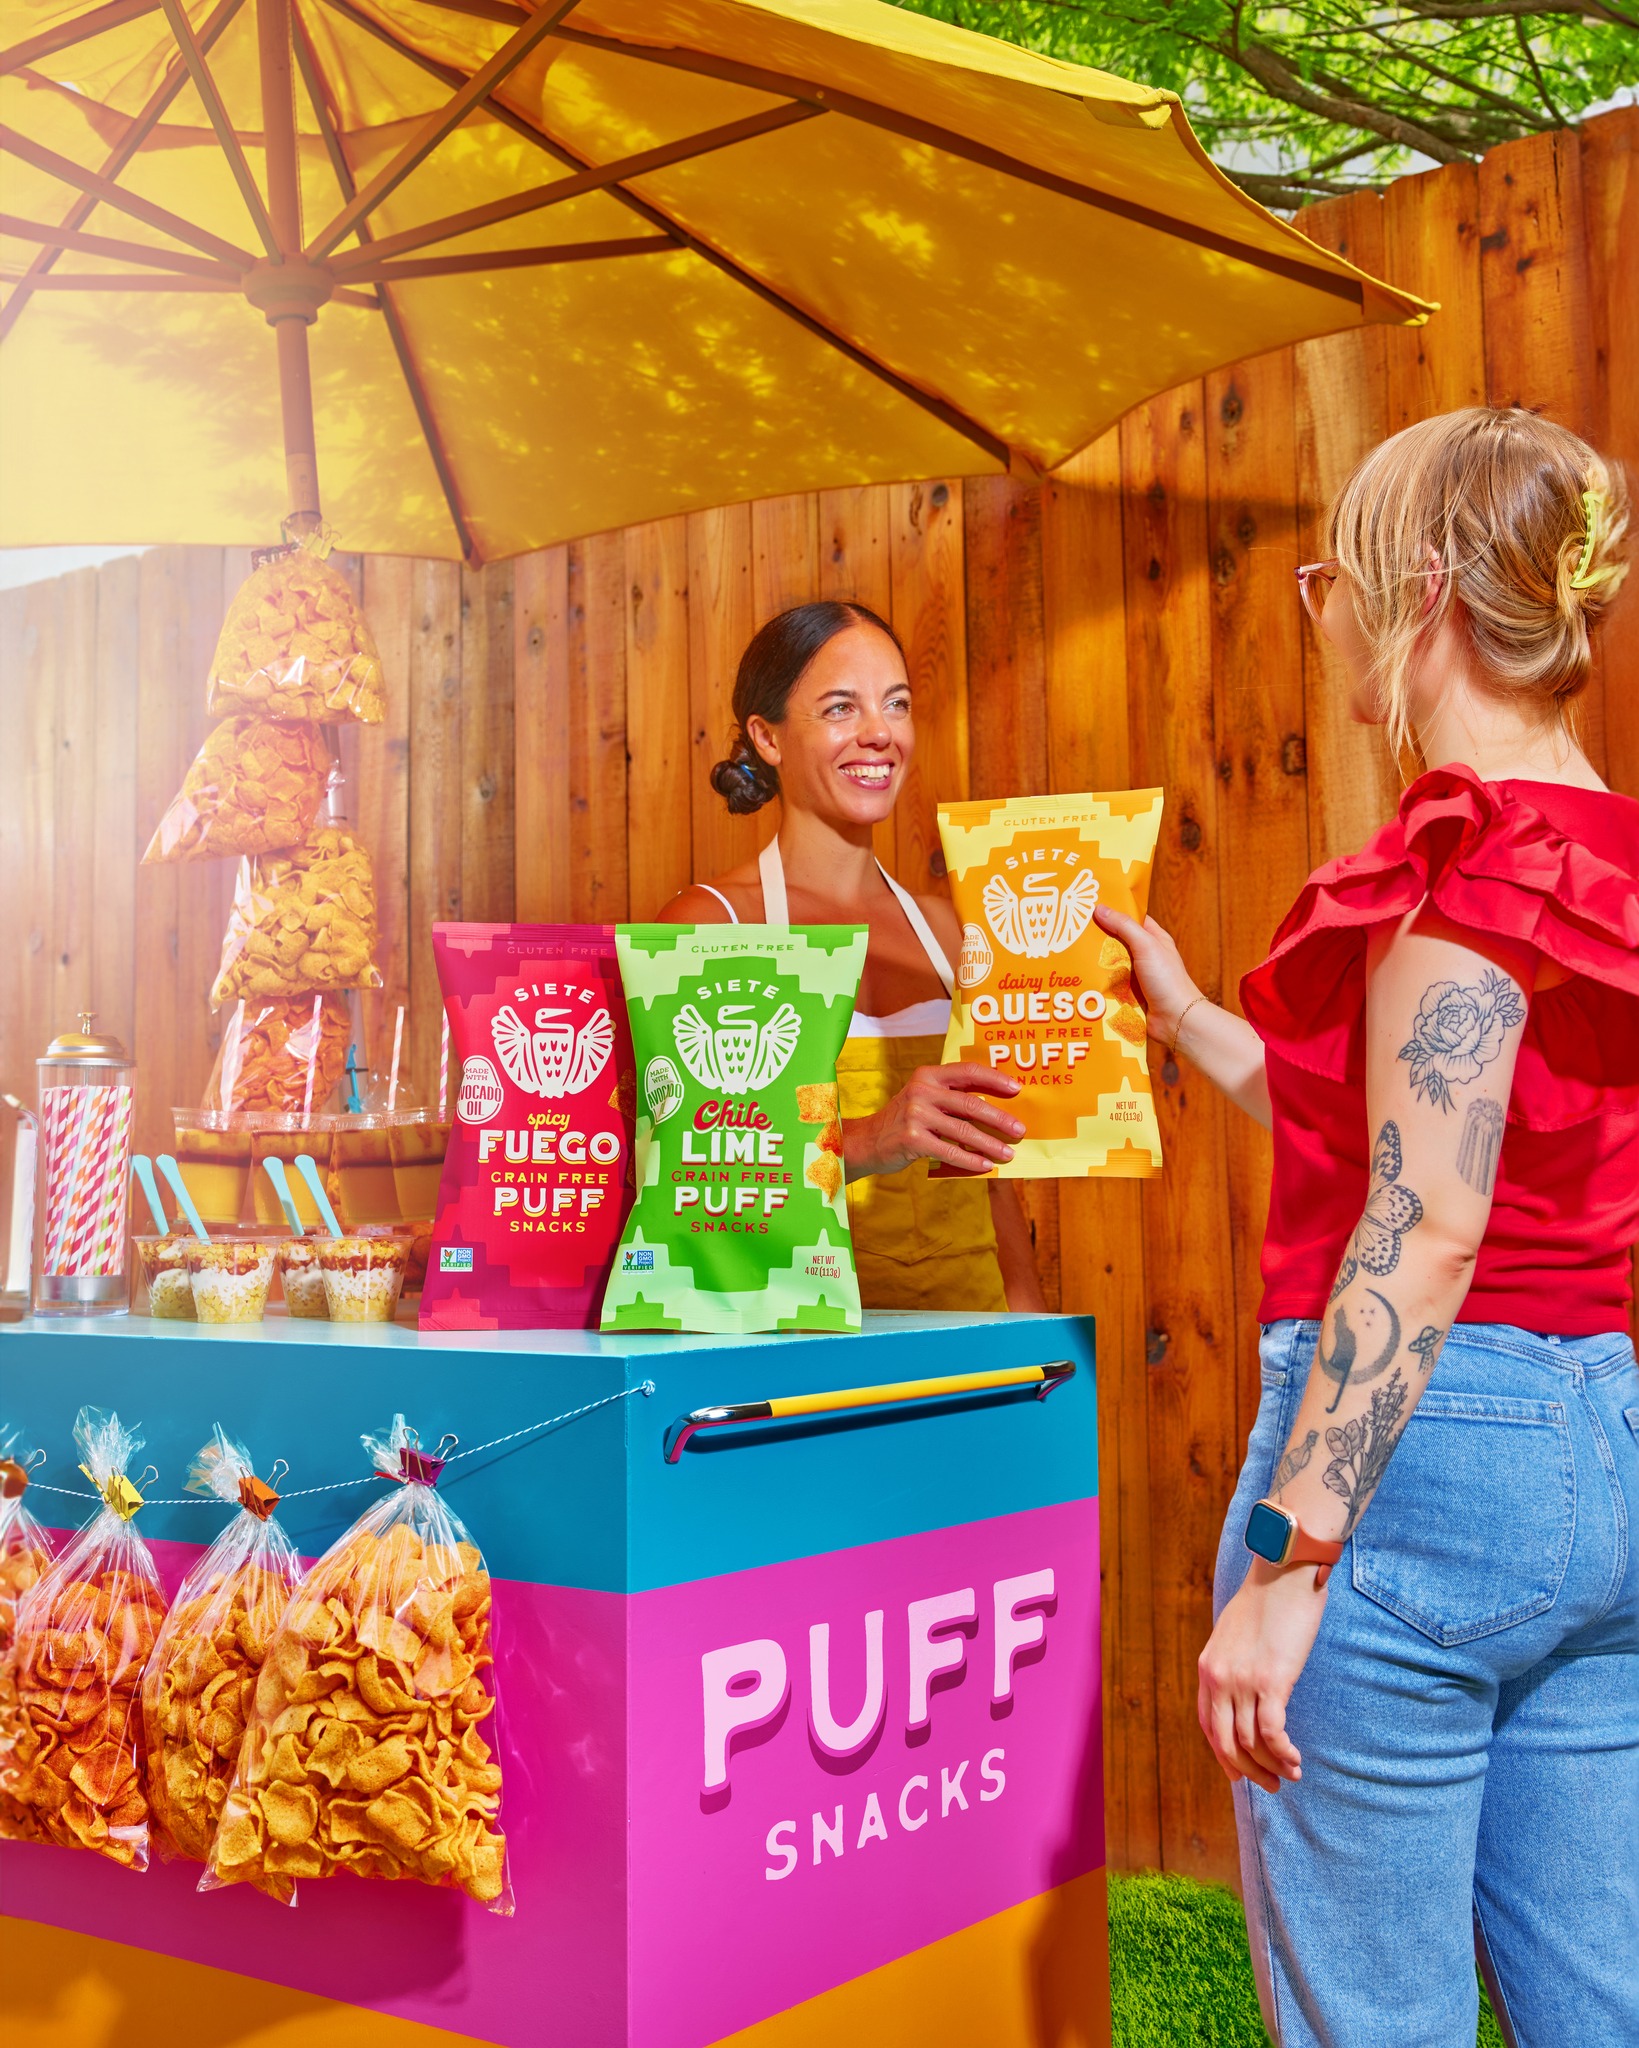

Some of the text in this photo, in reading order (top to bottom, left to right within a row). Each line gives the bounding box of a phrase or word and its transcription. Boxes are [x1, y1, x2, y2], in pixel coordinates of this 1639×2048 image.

[1003, 814, 1098, 826] GLUTEN FREE
[1005, 848, 1081, 870] SIETE
[507, 946, 608, 956] GLUTEN FREE
[691, 944, 749, 953] GLUTEN
[960, 951, 992, 966] OCADO
[962, 966, 975, 980] OIL
[696, 979, 780, 1000] SIETE
[998, 970, 1083, 994] dairy free
[514, 983, 596, 1004] SIETE
[970, 990, 1107, 1026] QUESO
[984, 1027, 1093, 1041] GRAIN FREE
[988, 1041, 1090, 1071] PUFF
[650, 1067, 670, 1078] MADE
[652, 1073, 669, 1084] WITH
[1010, 1073, 1074, 1086] NACKS
[459, 1085, 502, 1102] VOCADO
[467, 1101, 482, 1116] OIL
[1116, 1101, 1137, 1110] NET WT
[527, 1109, 571, 1132] spicy
[692, 1099, 773, 1133] Chile
[1109, 1110, 1143, 1122] 4 OZ (113g)
[478, 1129, 621, 1165] FUEGO
[681, 1131, 784, 1167] LIME
[491, 1171, 609, 1184] GRAIN FREE
[671, 1170, 793, 1184] GRAIN FREE
[493, 1187, 605, 1217] PUFF
[674, 1187, 789, 1218] PUFF
[510, 1221, 586, 1233] SNACKS
[690, 1221, 769, 1234] SNACKS
[812, 1255, 835, 1264] NET WT
[805, 1266, 840, 1278] 4 OZ (113g)
[700, 1568, 1058, 1815] PUFF
[765, 1748, 1007, 1881] SNACKS
